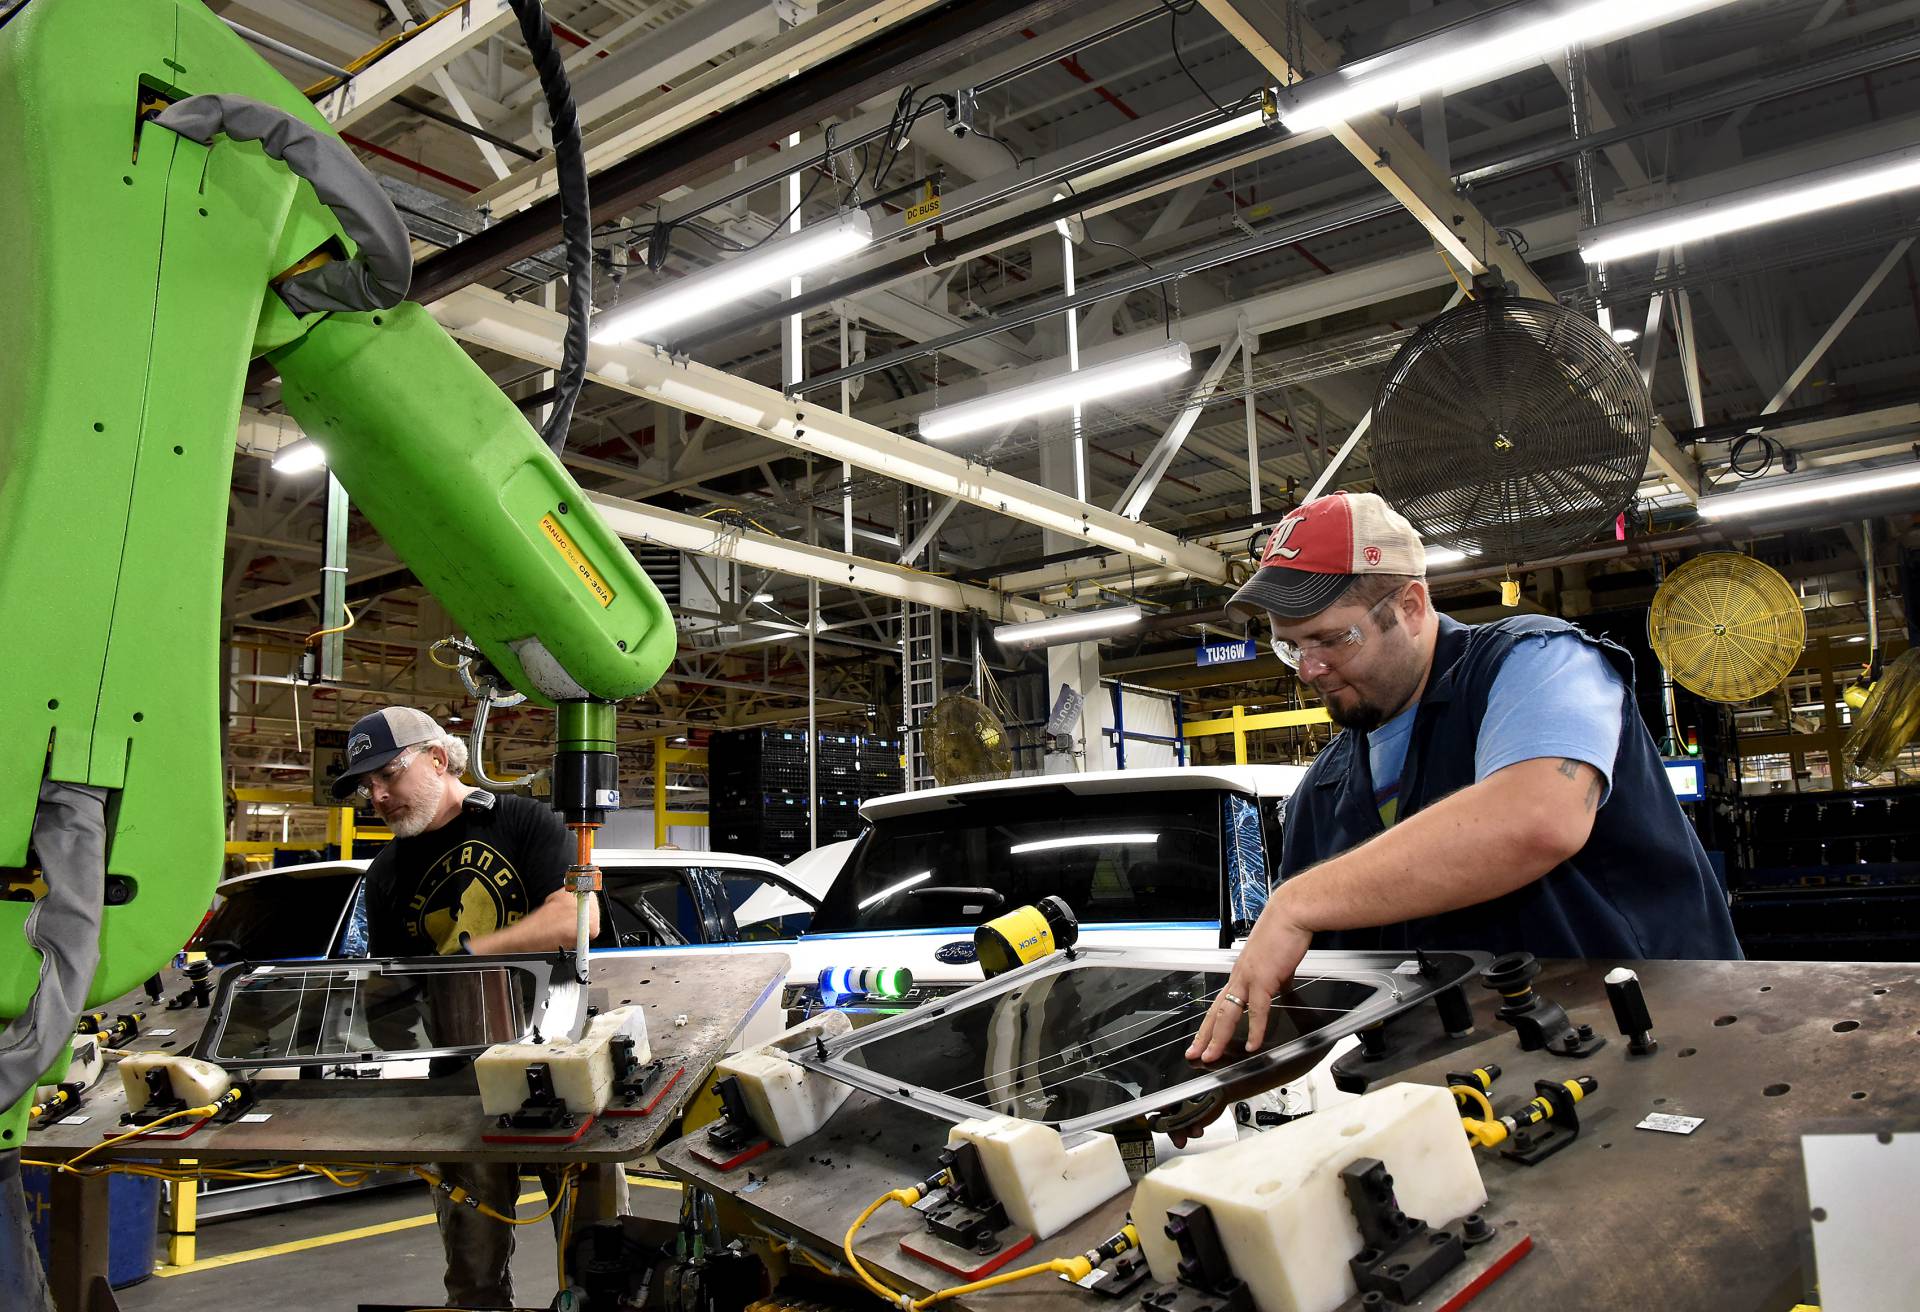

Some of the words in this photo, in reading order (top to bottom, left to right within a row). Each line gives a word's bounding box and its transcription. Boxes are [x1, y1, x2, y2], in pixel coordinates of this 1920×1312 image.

[907, 208, 918, 220] DC
[919, 200, 940, 215] BUSS
[543, 519, 567, 549] FANUC
[1265, 516, 1306, 561] L
[1206, 643, 1246, 662] TU316W
[1051, 694, 1075, 729] ROUTE
[1019, 935, 1038, 950] SICK
